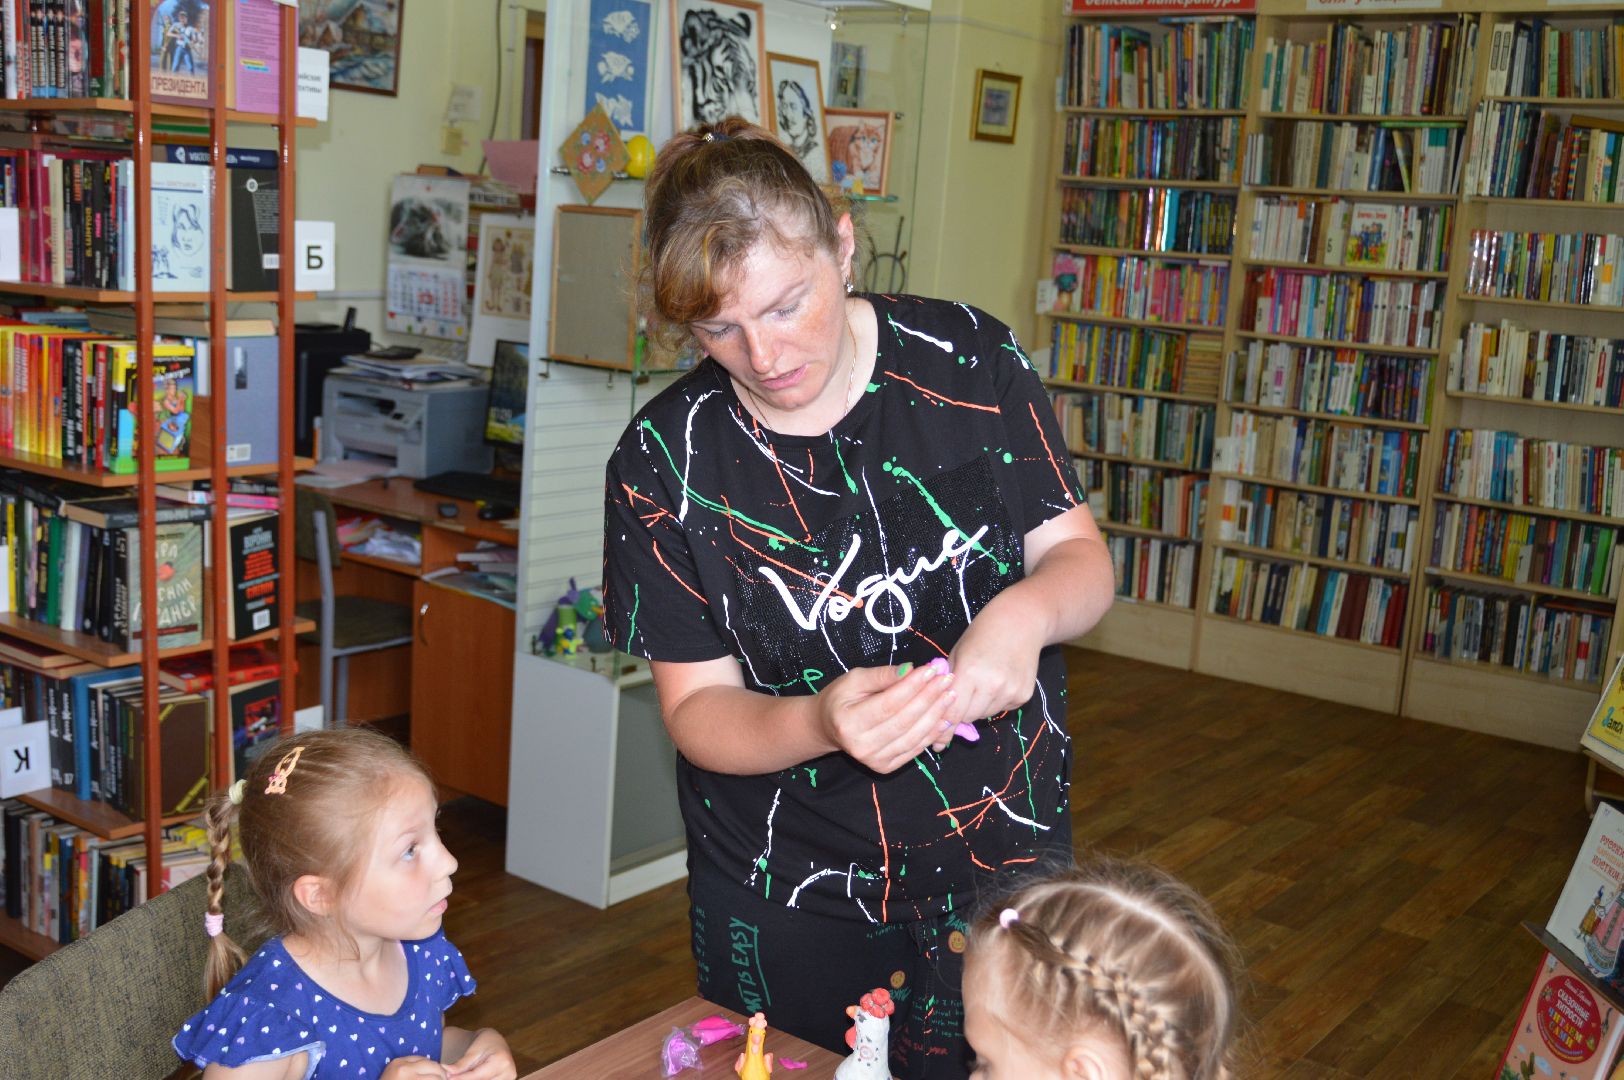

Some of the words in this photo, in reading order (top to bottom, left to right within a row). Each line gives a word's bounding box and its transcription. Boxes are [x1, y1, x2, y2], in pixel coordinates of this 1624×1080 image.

[151, 76, 206, 94] ПРЕЗИДЕНТА
[305, 245, 324, 270] Б
[758, 525, 989, 634] Vogue
[729, 916, 759, 967] EASY
[1558, 988, 1590, 1021] СКАЗОЧНЫЕ
